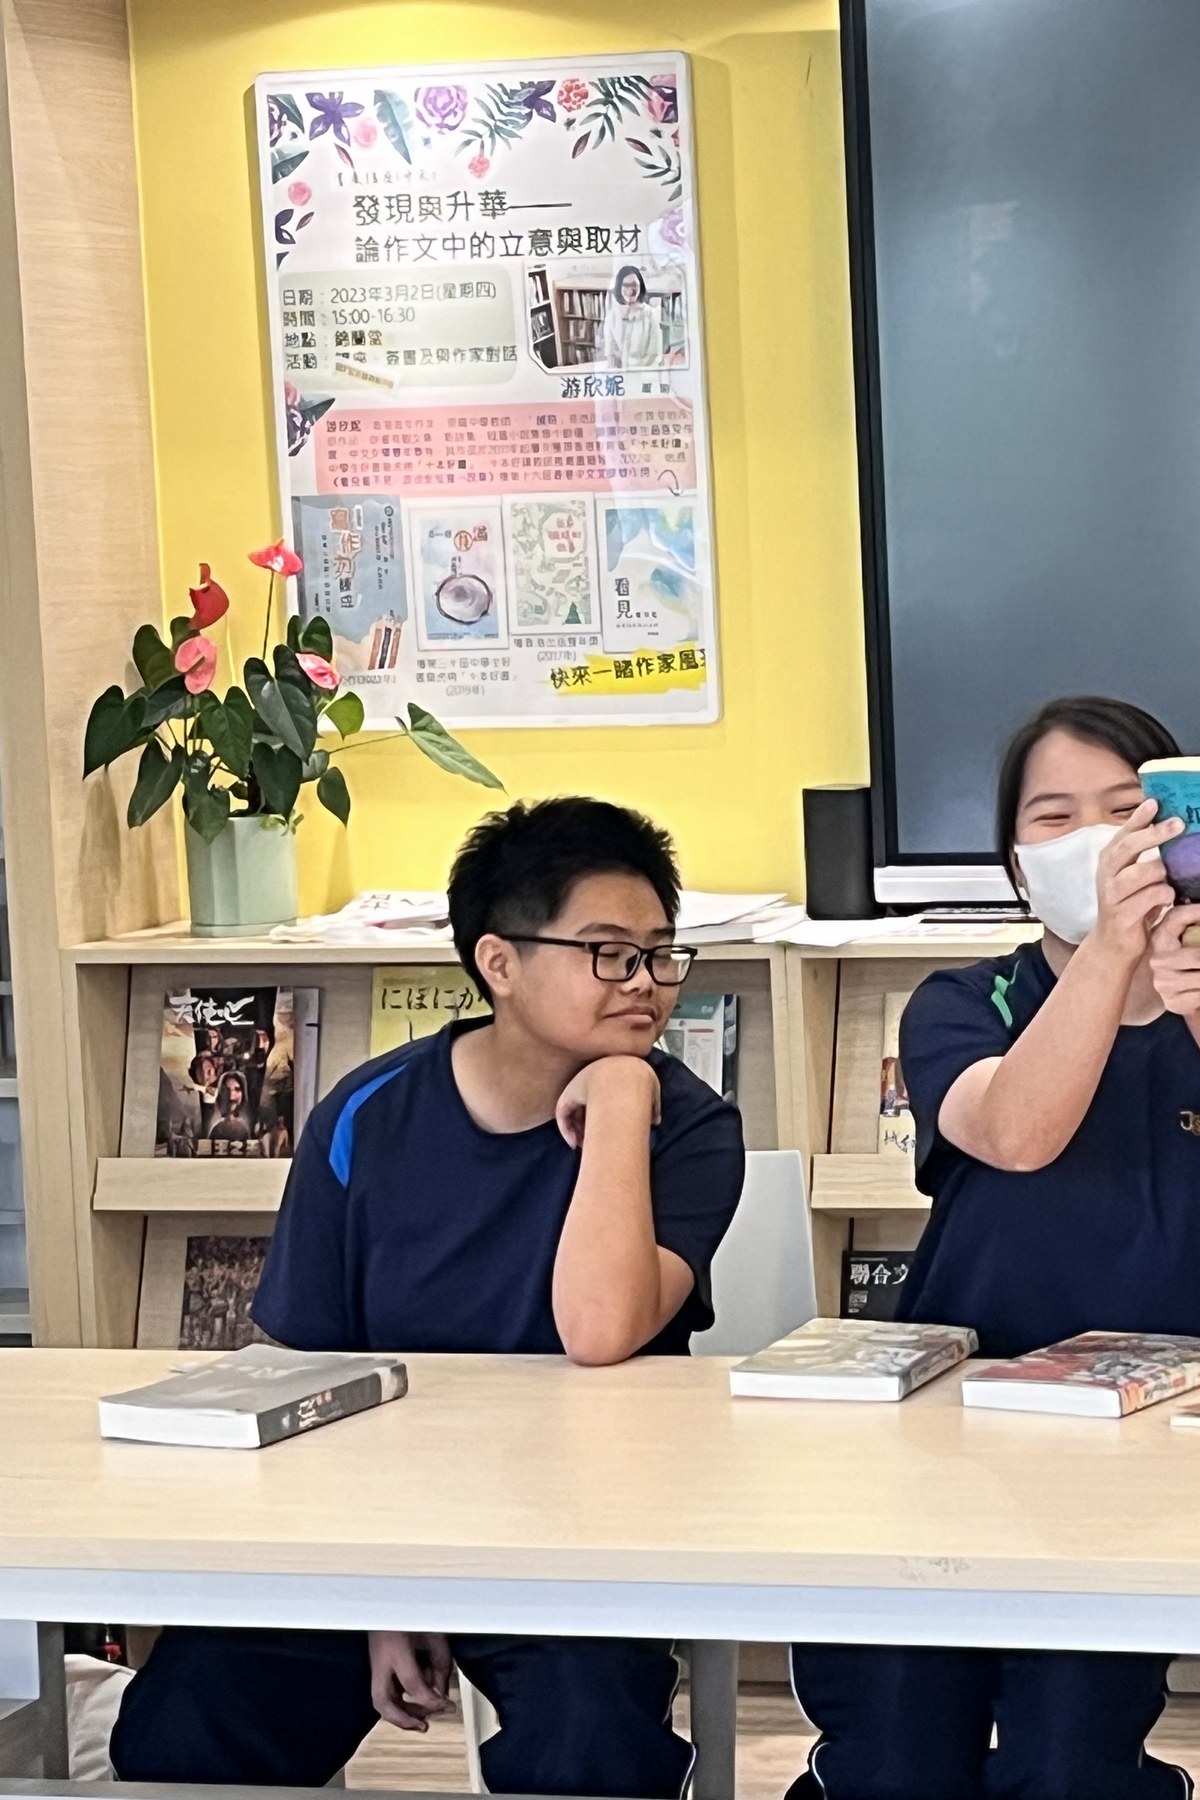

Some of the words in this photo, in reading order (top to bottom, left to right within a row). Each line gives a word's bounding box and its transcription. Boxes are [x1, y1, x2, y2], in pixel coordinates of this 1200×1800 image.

[355, 223, 642, 263] 論作文中的立意與取材
